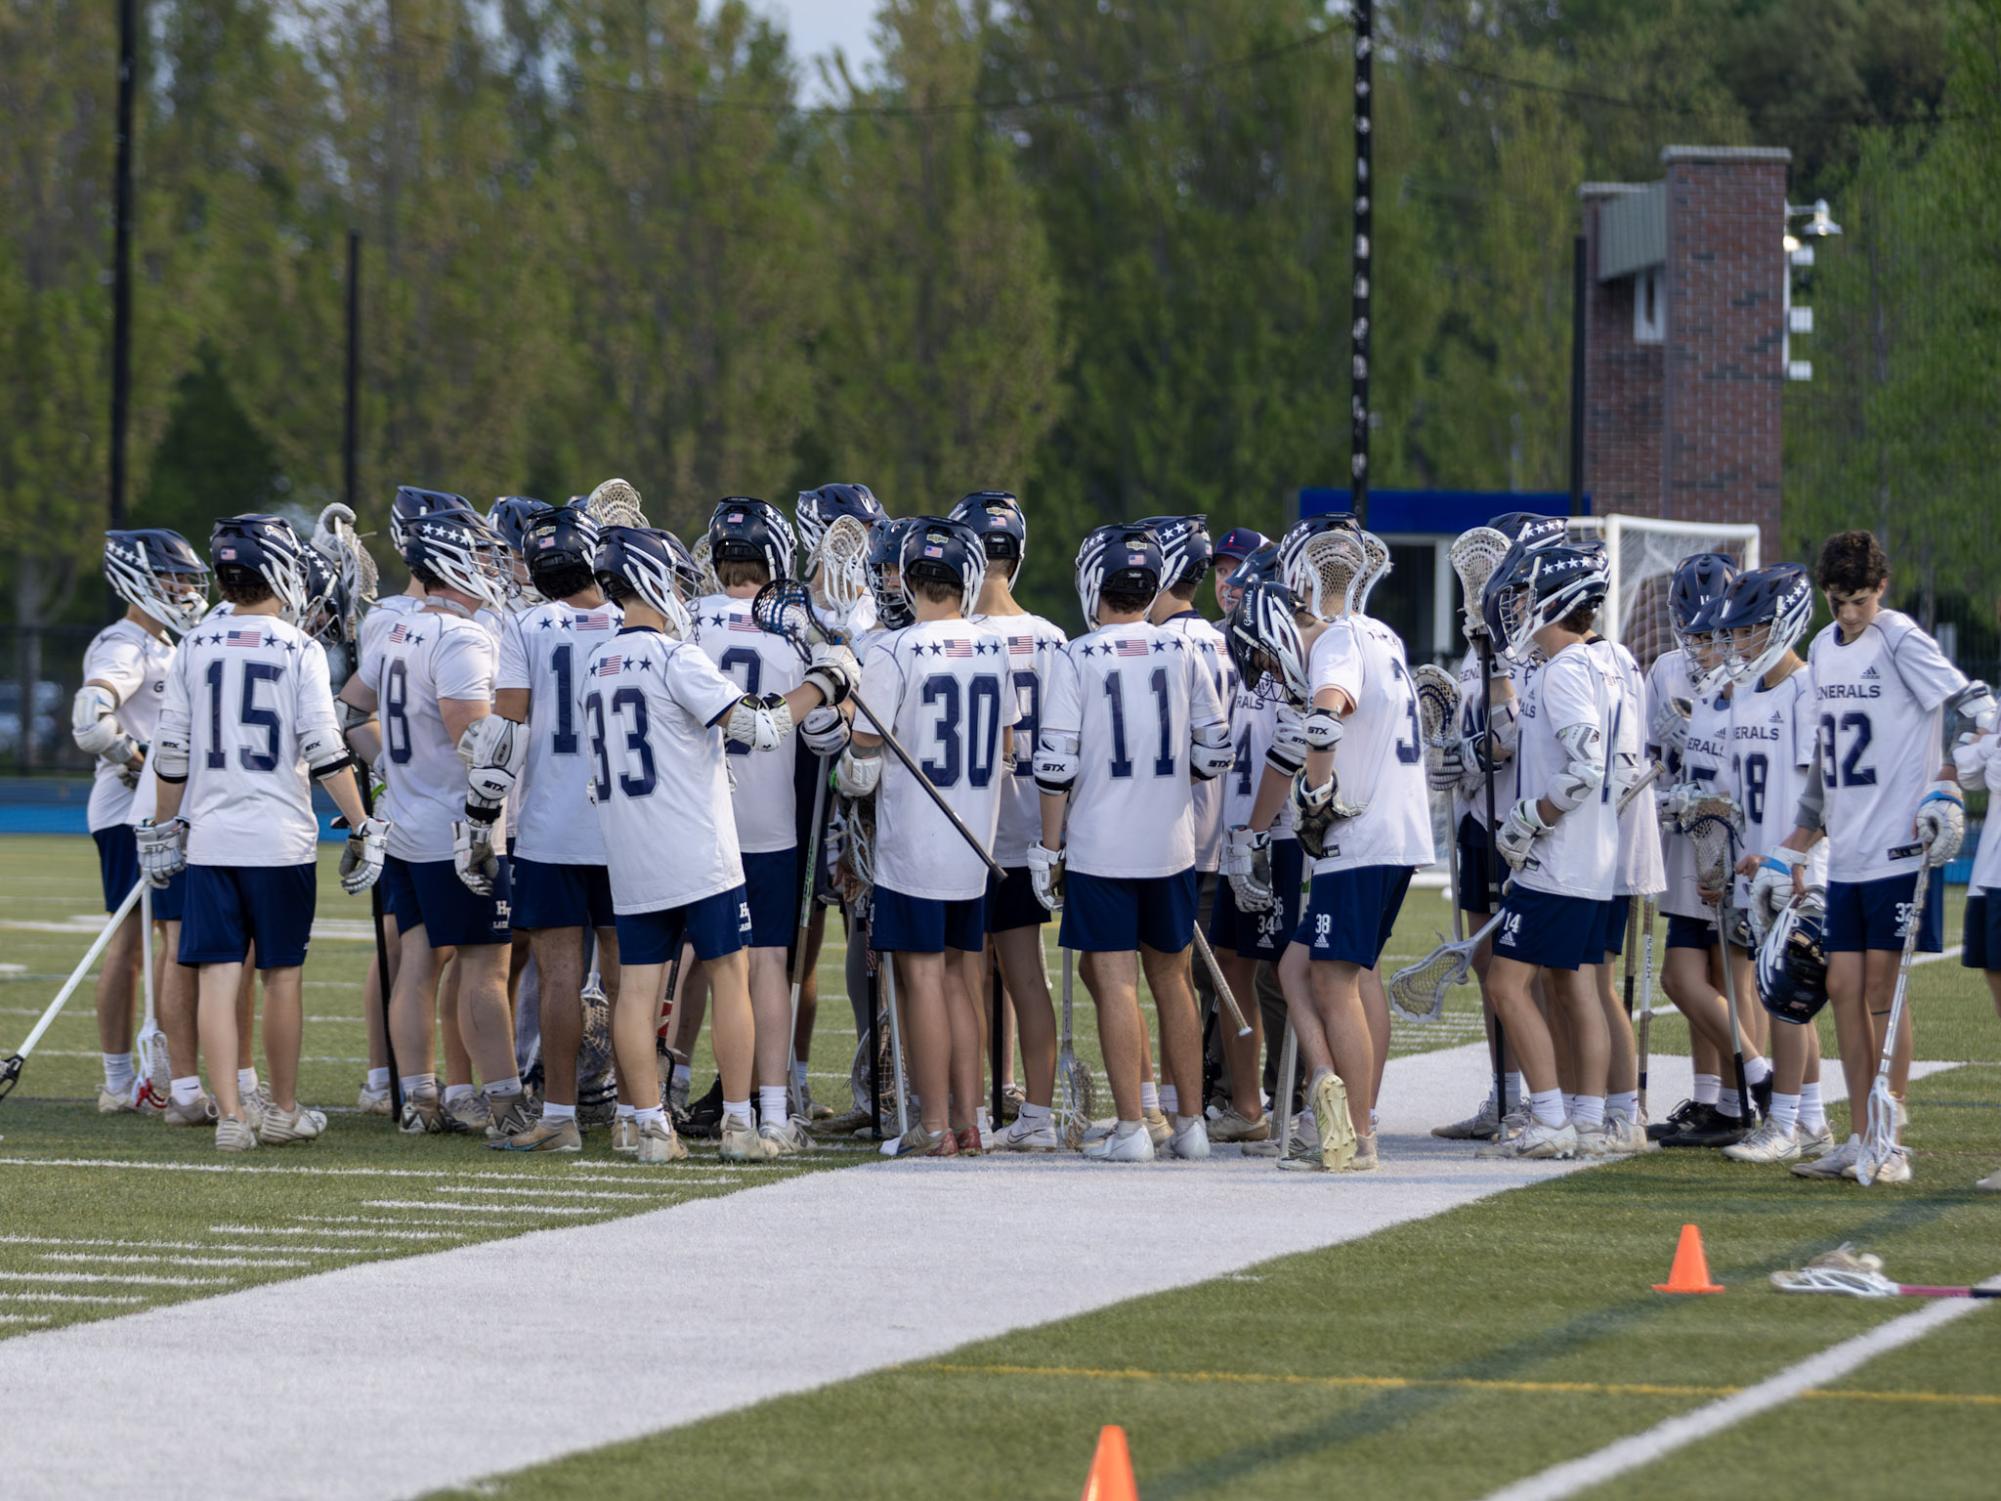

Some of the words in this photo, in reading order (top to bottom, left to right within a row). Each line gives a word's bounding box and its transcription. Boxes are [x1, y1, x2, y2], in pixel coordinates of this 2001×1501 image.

[204, 657, 287, 773] 15
[379, 655, 413, 766] 8
[919, 672, 1001, 790] 30
[1102, 666, 1176, 780] 11
[1307, 726, 1329, 736] STX
[585, 686, 657, 804] 33
[1820, 710, 1877, 788] 32
[1041, 763, 1066, 772] STX
[1207, 760, 1231, 768] STX
[482, 780, 507, 792] STX
[1257, 914, 1276, 935] 34
[1315, 913, 1331, 934] 38
[1503, 911, 1521, 934] 14
